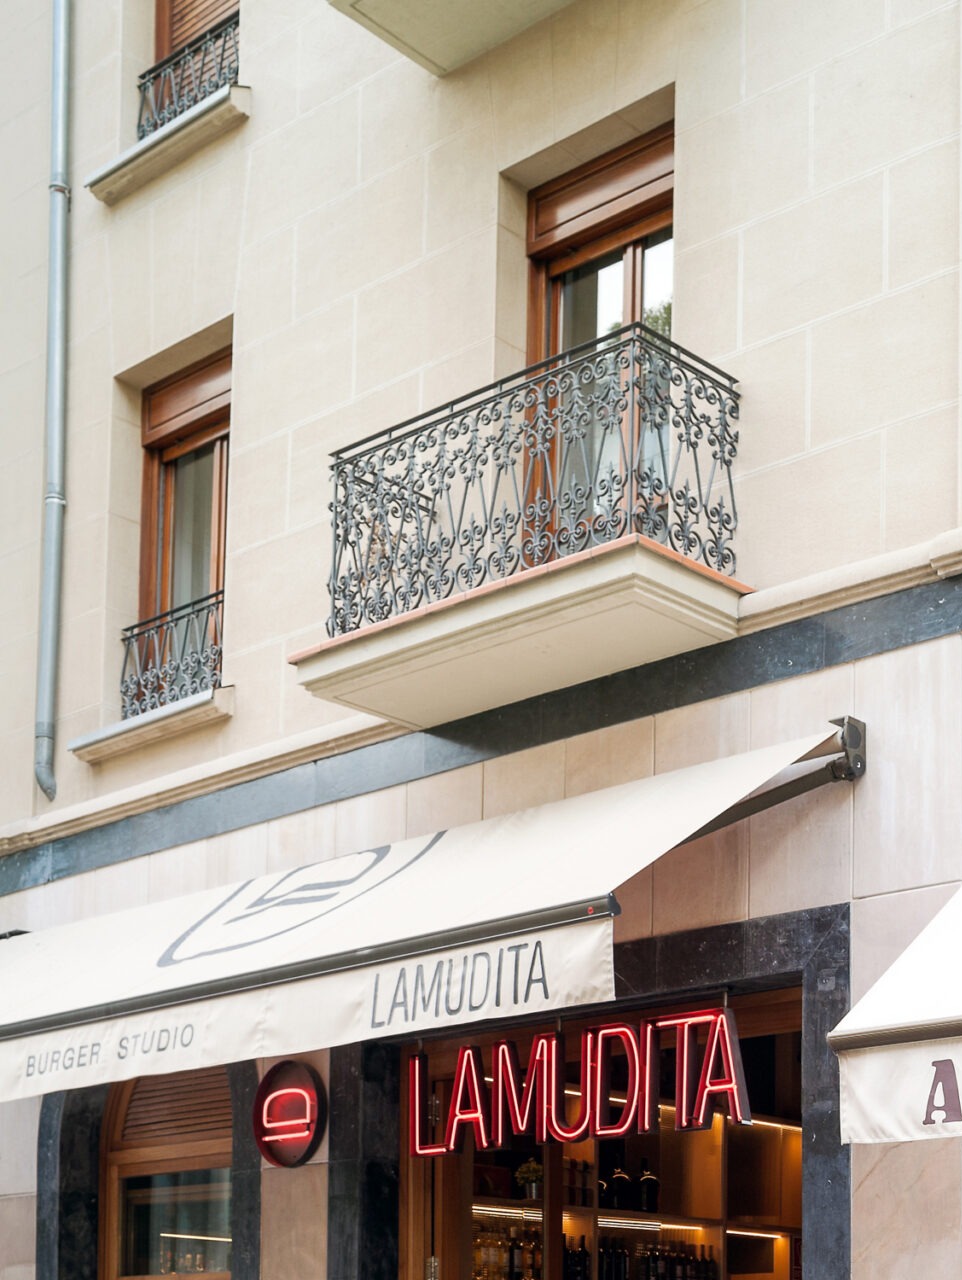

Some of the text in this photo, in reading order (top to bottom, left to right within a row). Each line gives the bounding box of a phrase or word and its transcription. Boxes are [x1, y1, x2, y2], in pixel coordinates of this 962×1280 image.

[371, 940, 549, 1029] LAMUDITA
[25, 1023, 195, 1078] BURGER STUDIO
[409, 1007, 750, 1157] LAMUDITA
